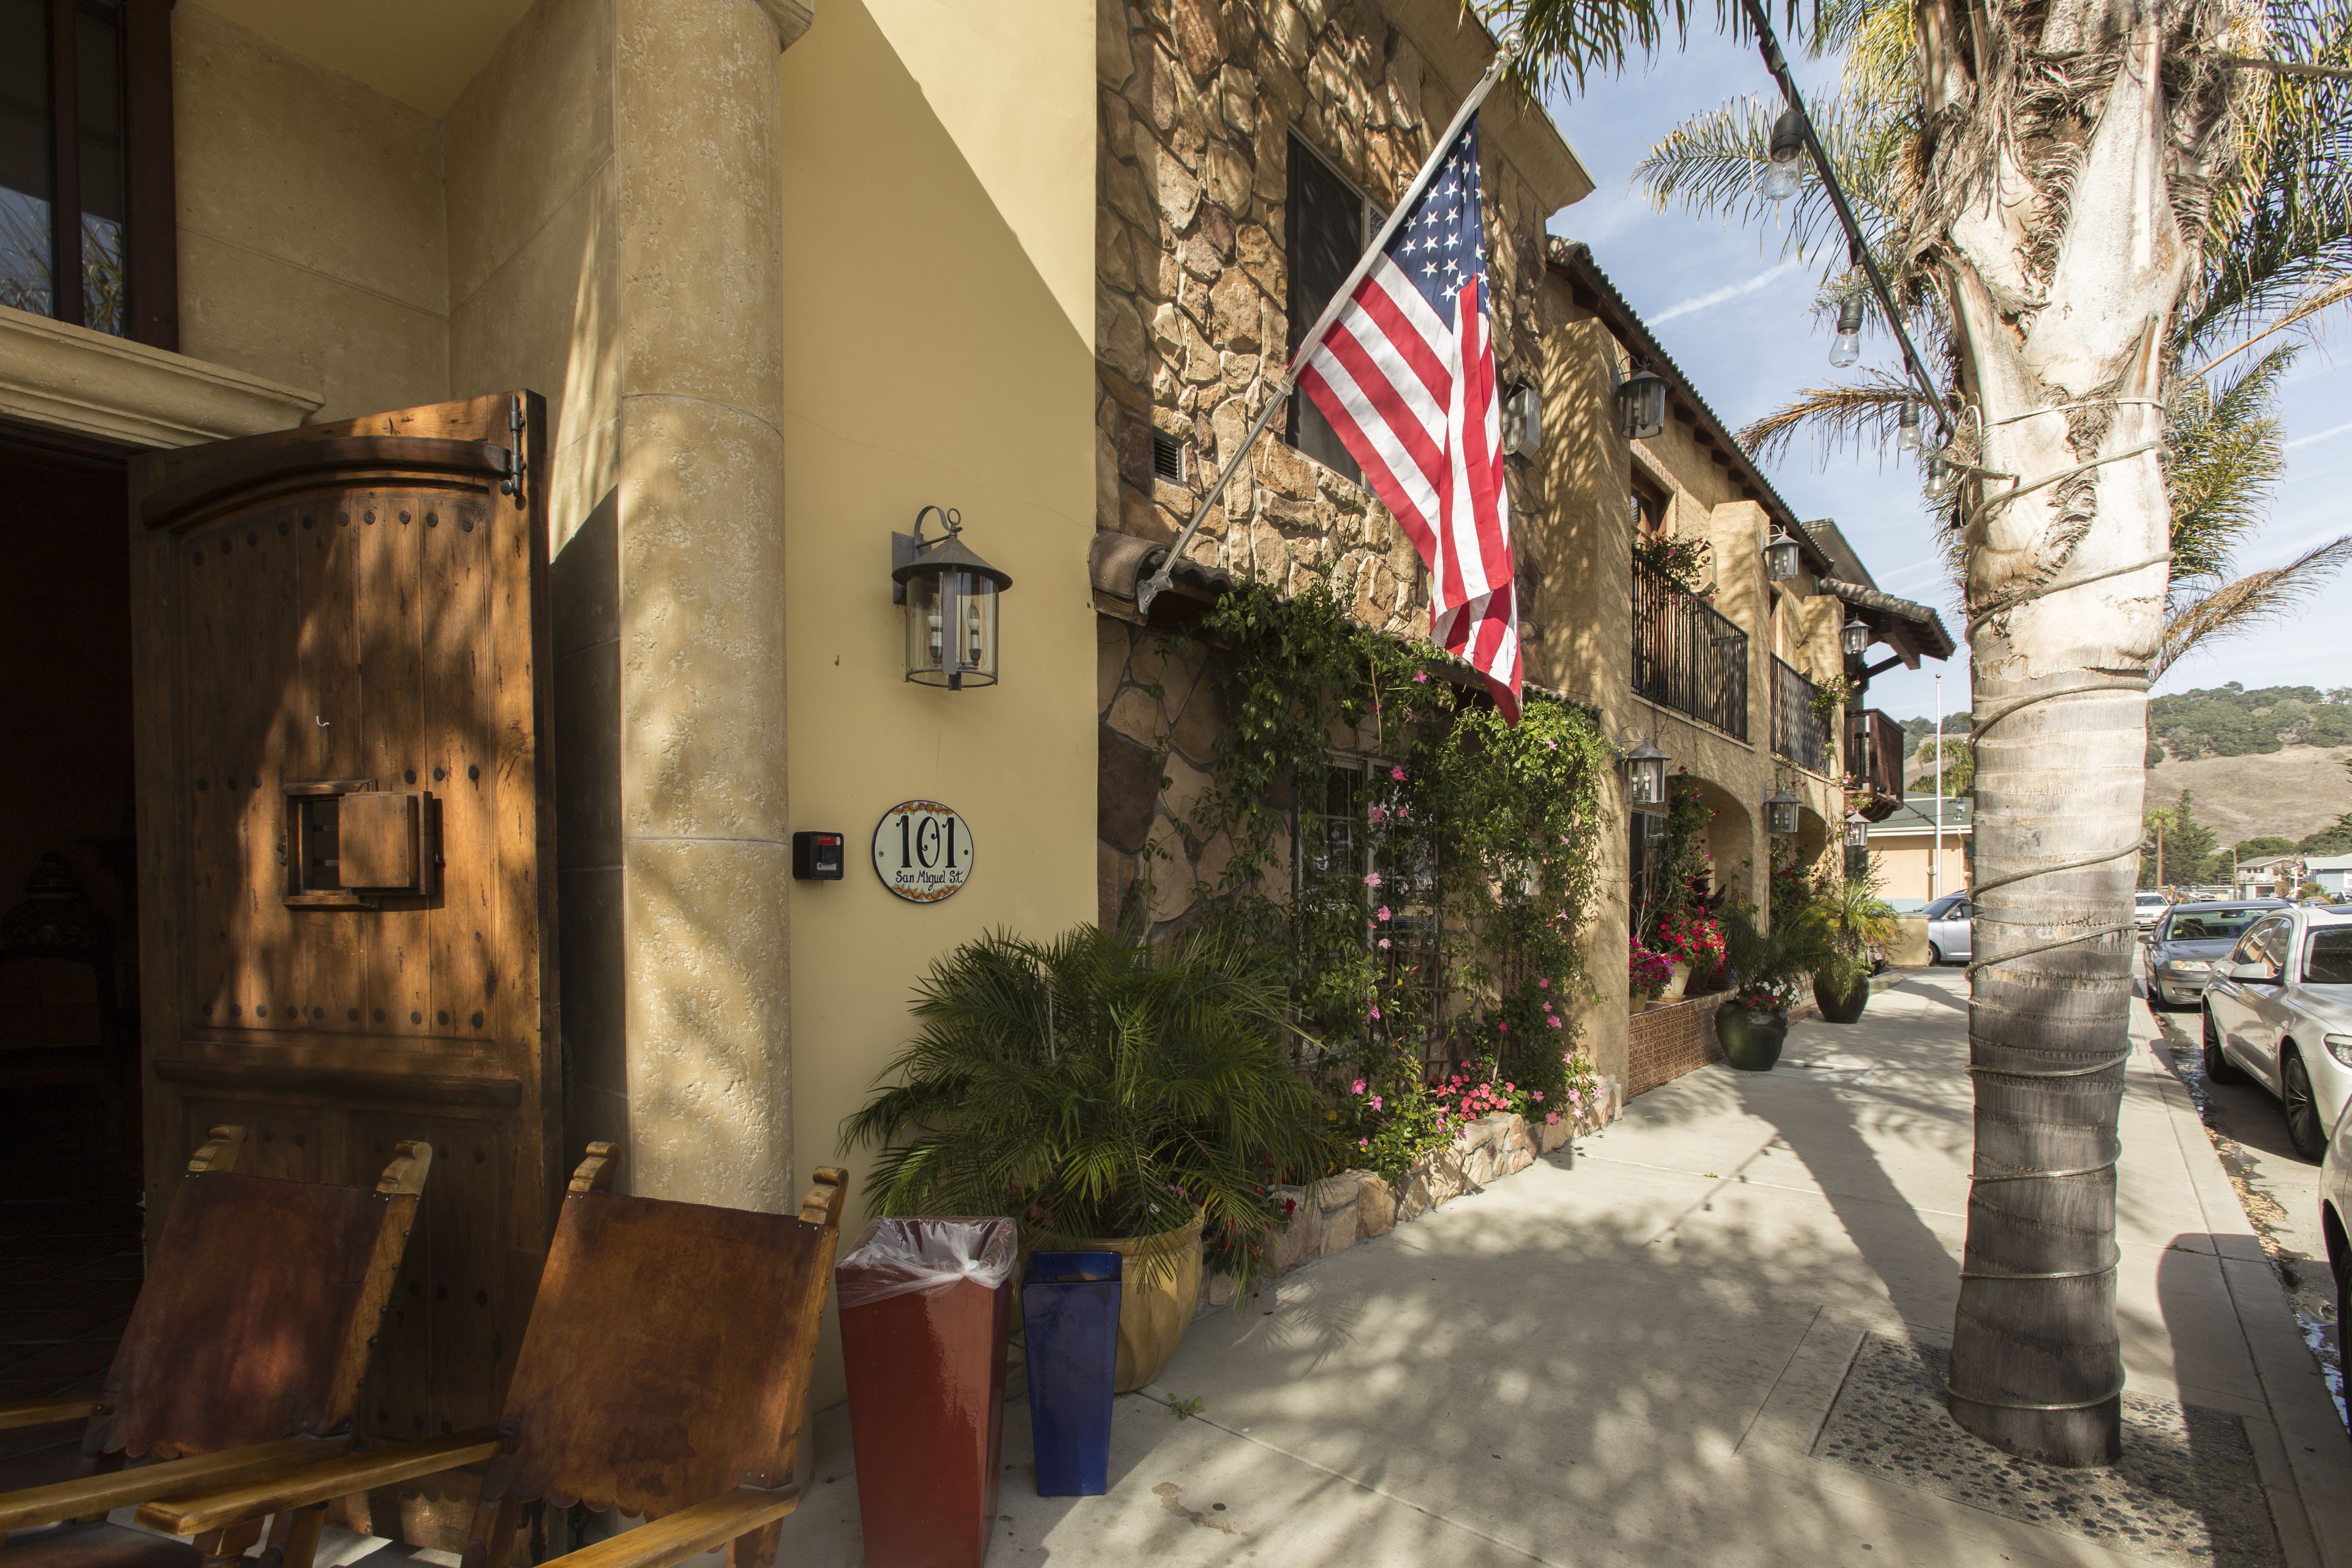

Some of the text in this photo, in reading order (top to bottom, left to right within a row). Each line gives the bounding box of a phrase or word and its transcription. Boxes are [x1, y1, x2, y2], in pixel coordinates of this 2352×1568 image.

[896, 815, 957, 868] 101
[895, 870, 963, 891] San Miguel St.
